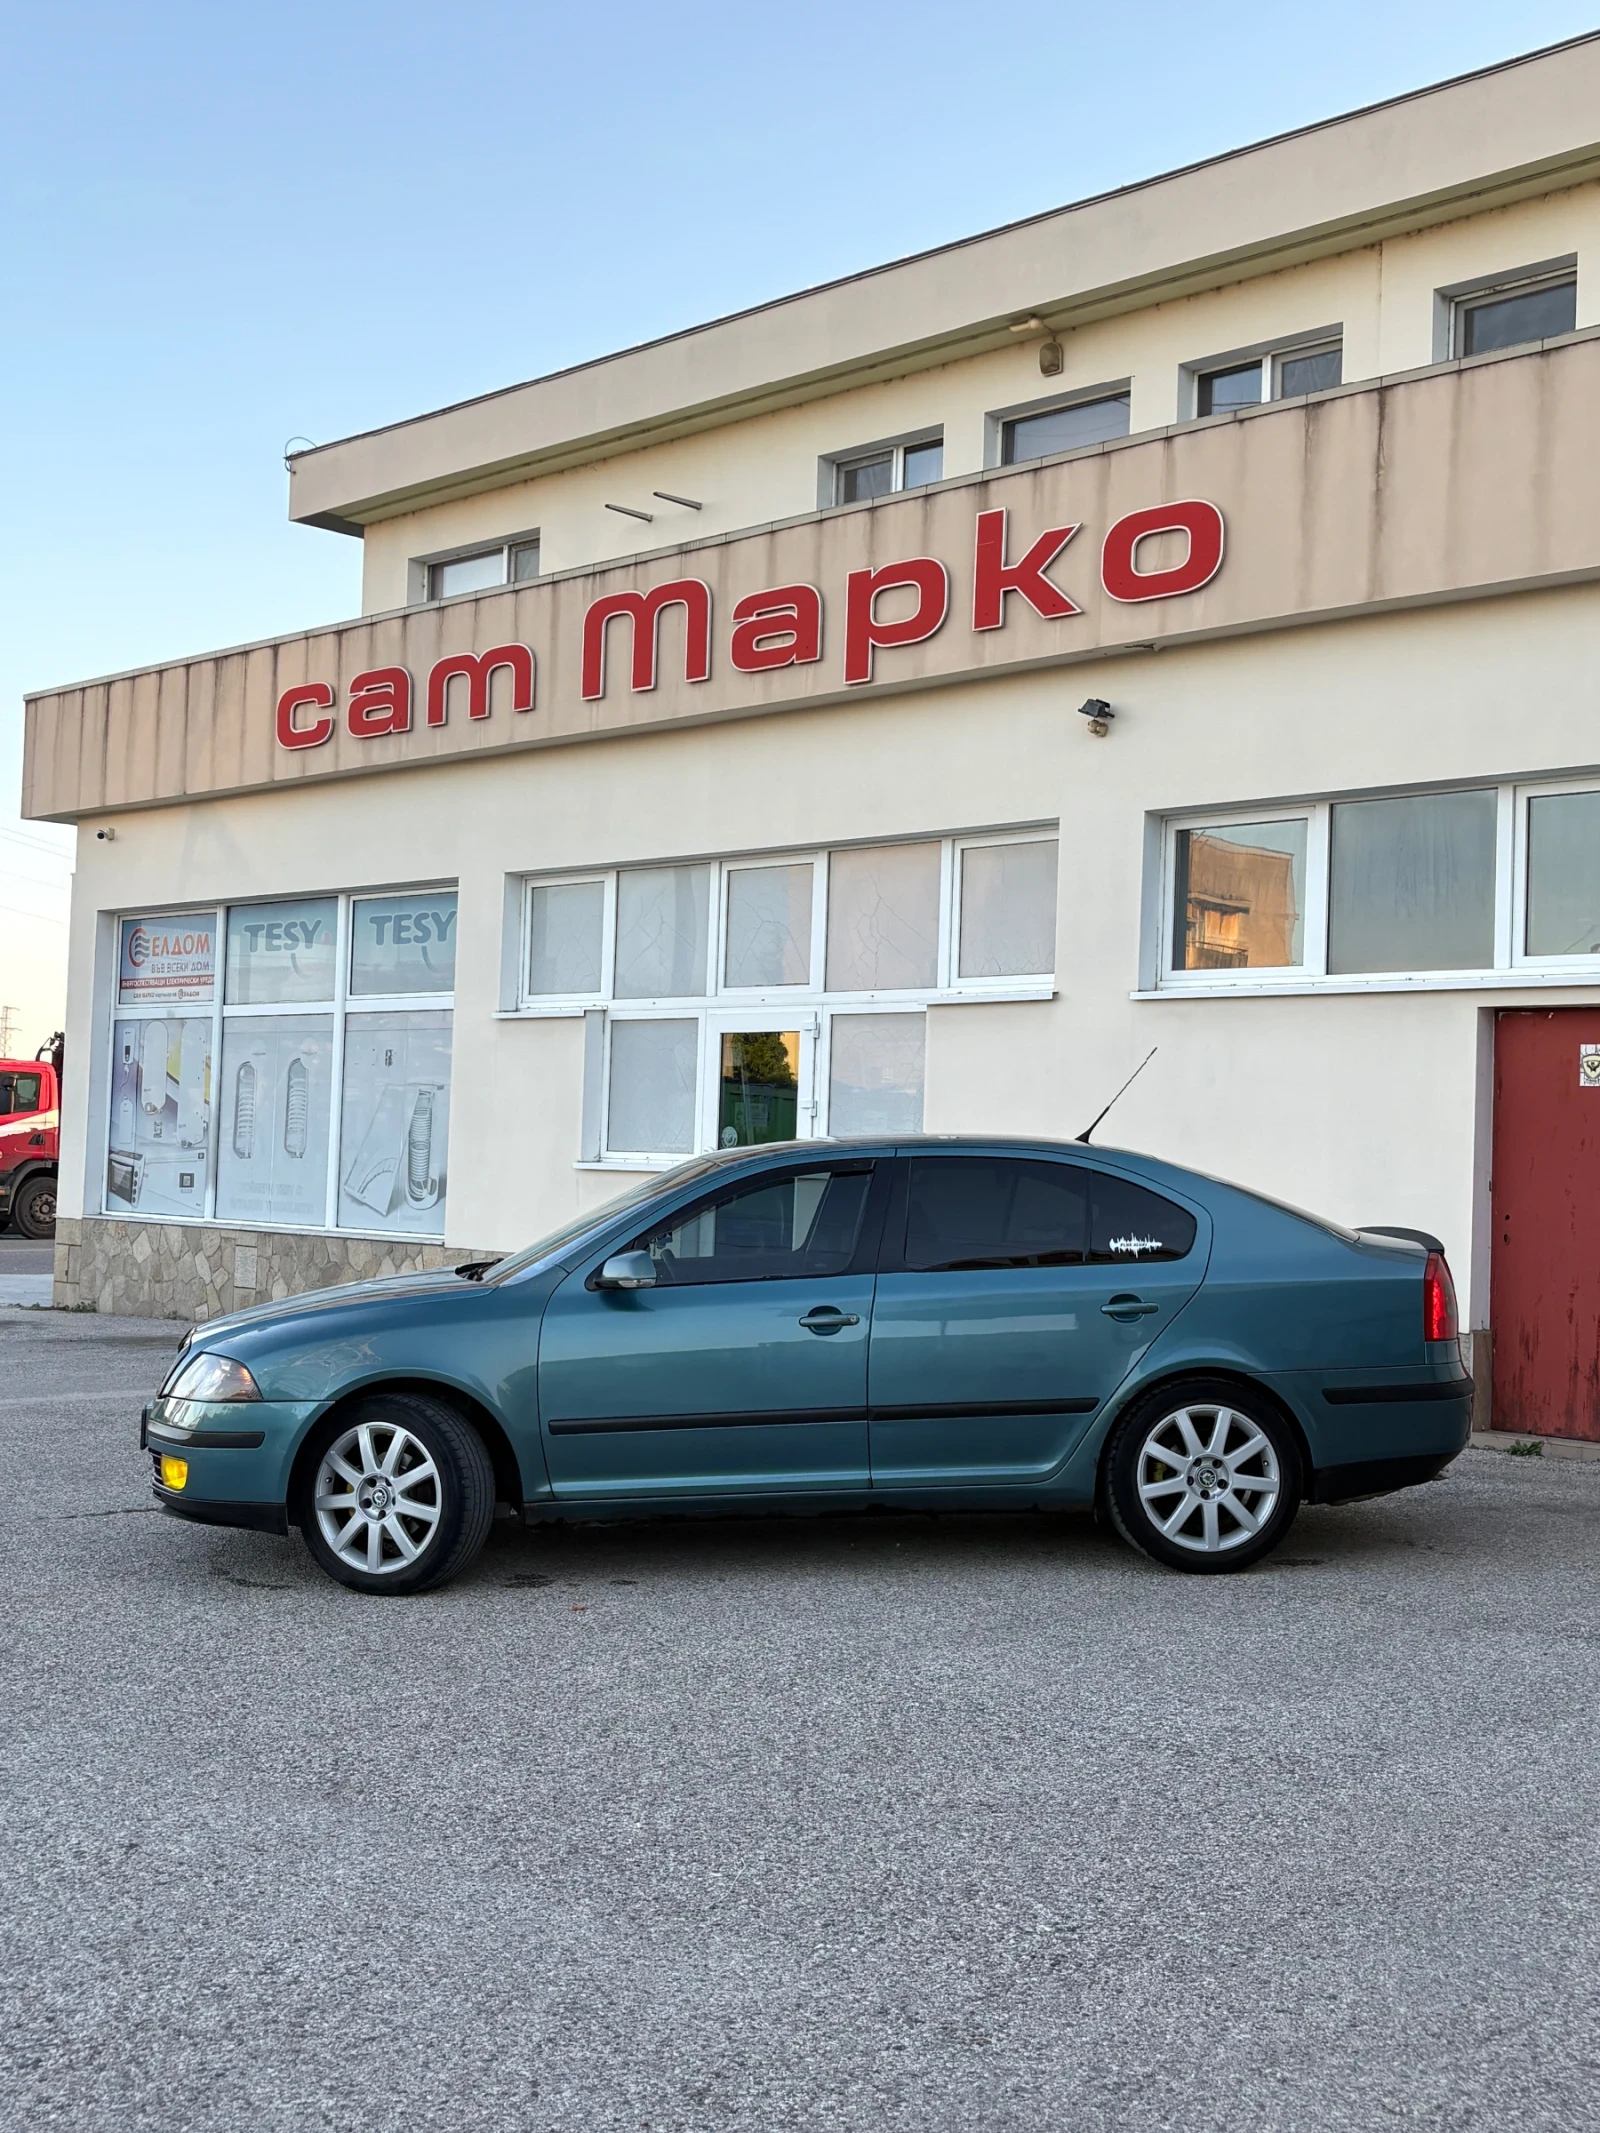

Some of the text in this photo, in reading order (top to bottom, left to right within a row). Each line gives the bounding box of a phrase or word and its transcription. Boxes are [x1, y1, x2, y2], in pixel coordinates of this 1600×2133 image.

[243, 919, 322, 953] TESY
[369, 909, 457, 946] TESY
[167, 962, 189, 973] ВСЕКИ
[190, 960, 210, 972] ДОМ
